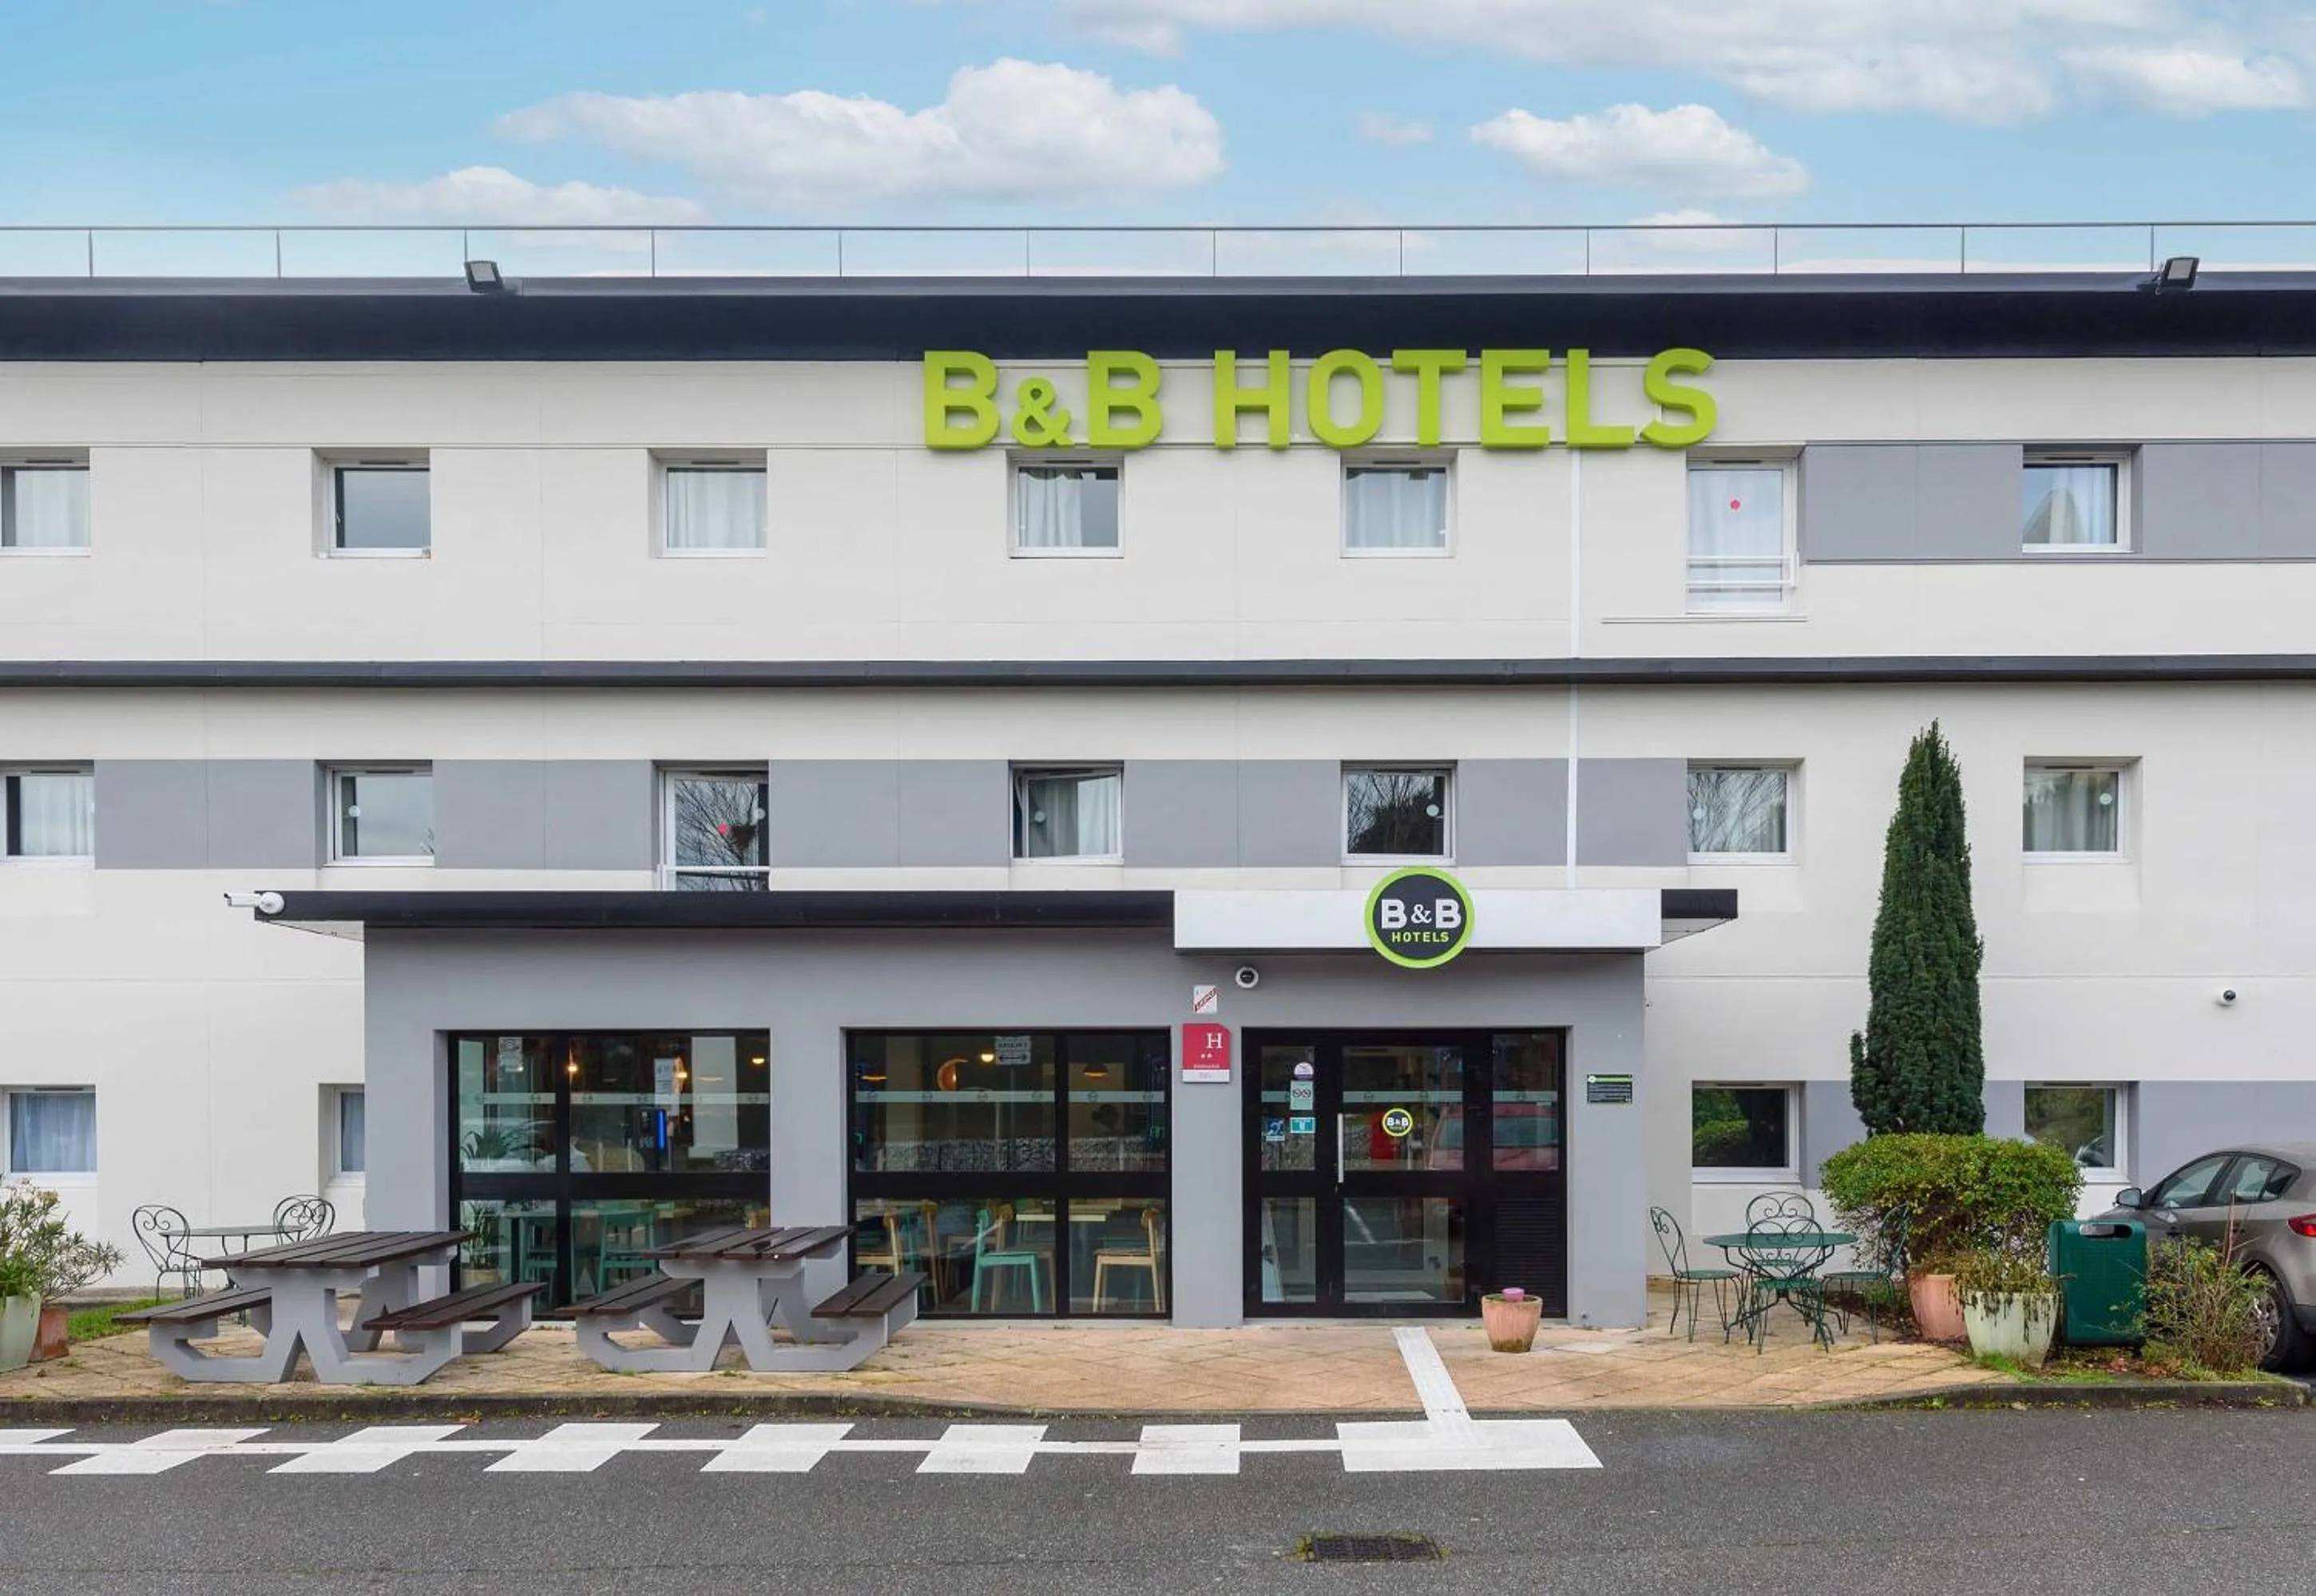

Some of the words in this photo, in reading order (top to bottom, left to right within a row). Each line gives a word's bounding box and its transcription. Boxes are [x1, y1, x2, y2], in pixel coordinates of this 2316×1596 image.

[923, 349, 1162, 451] B&B
[1213, 347, 1717, 451] HOTELS
[1381, 898, 1461, 929] B&B
[1391, 931, 1450, 943] HOTELS
[1206, 1032, 1223, 1049] H
